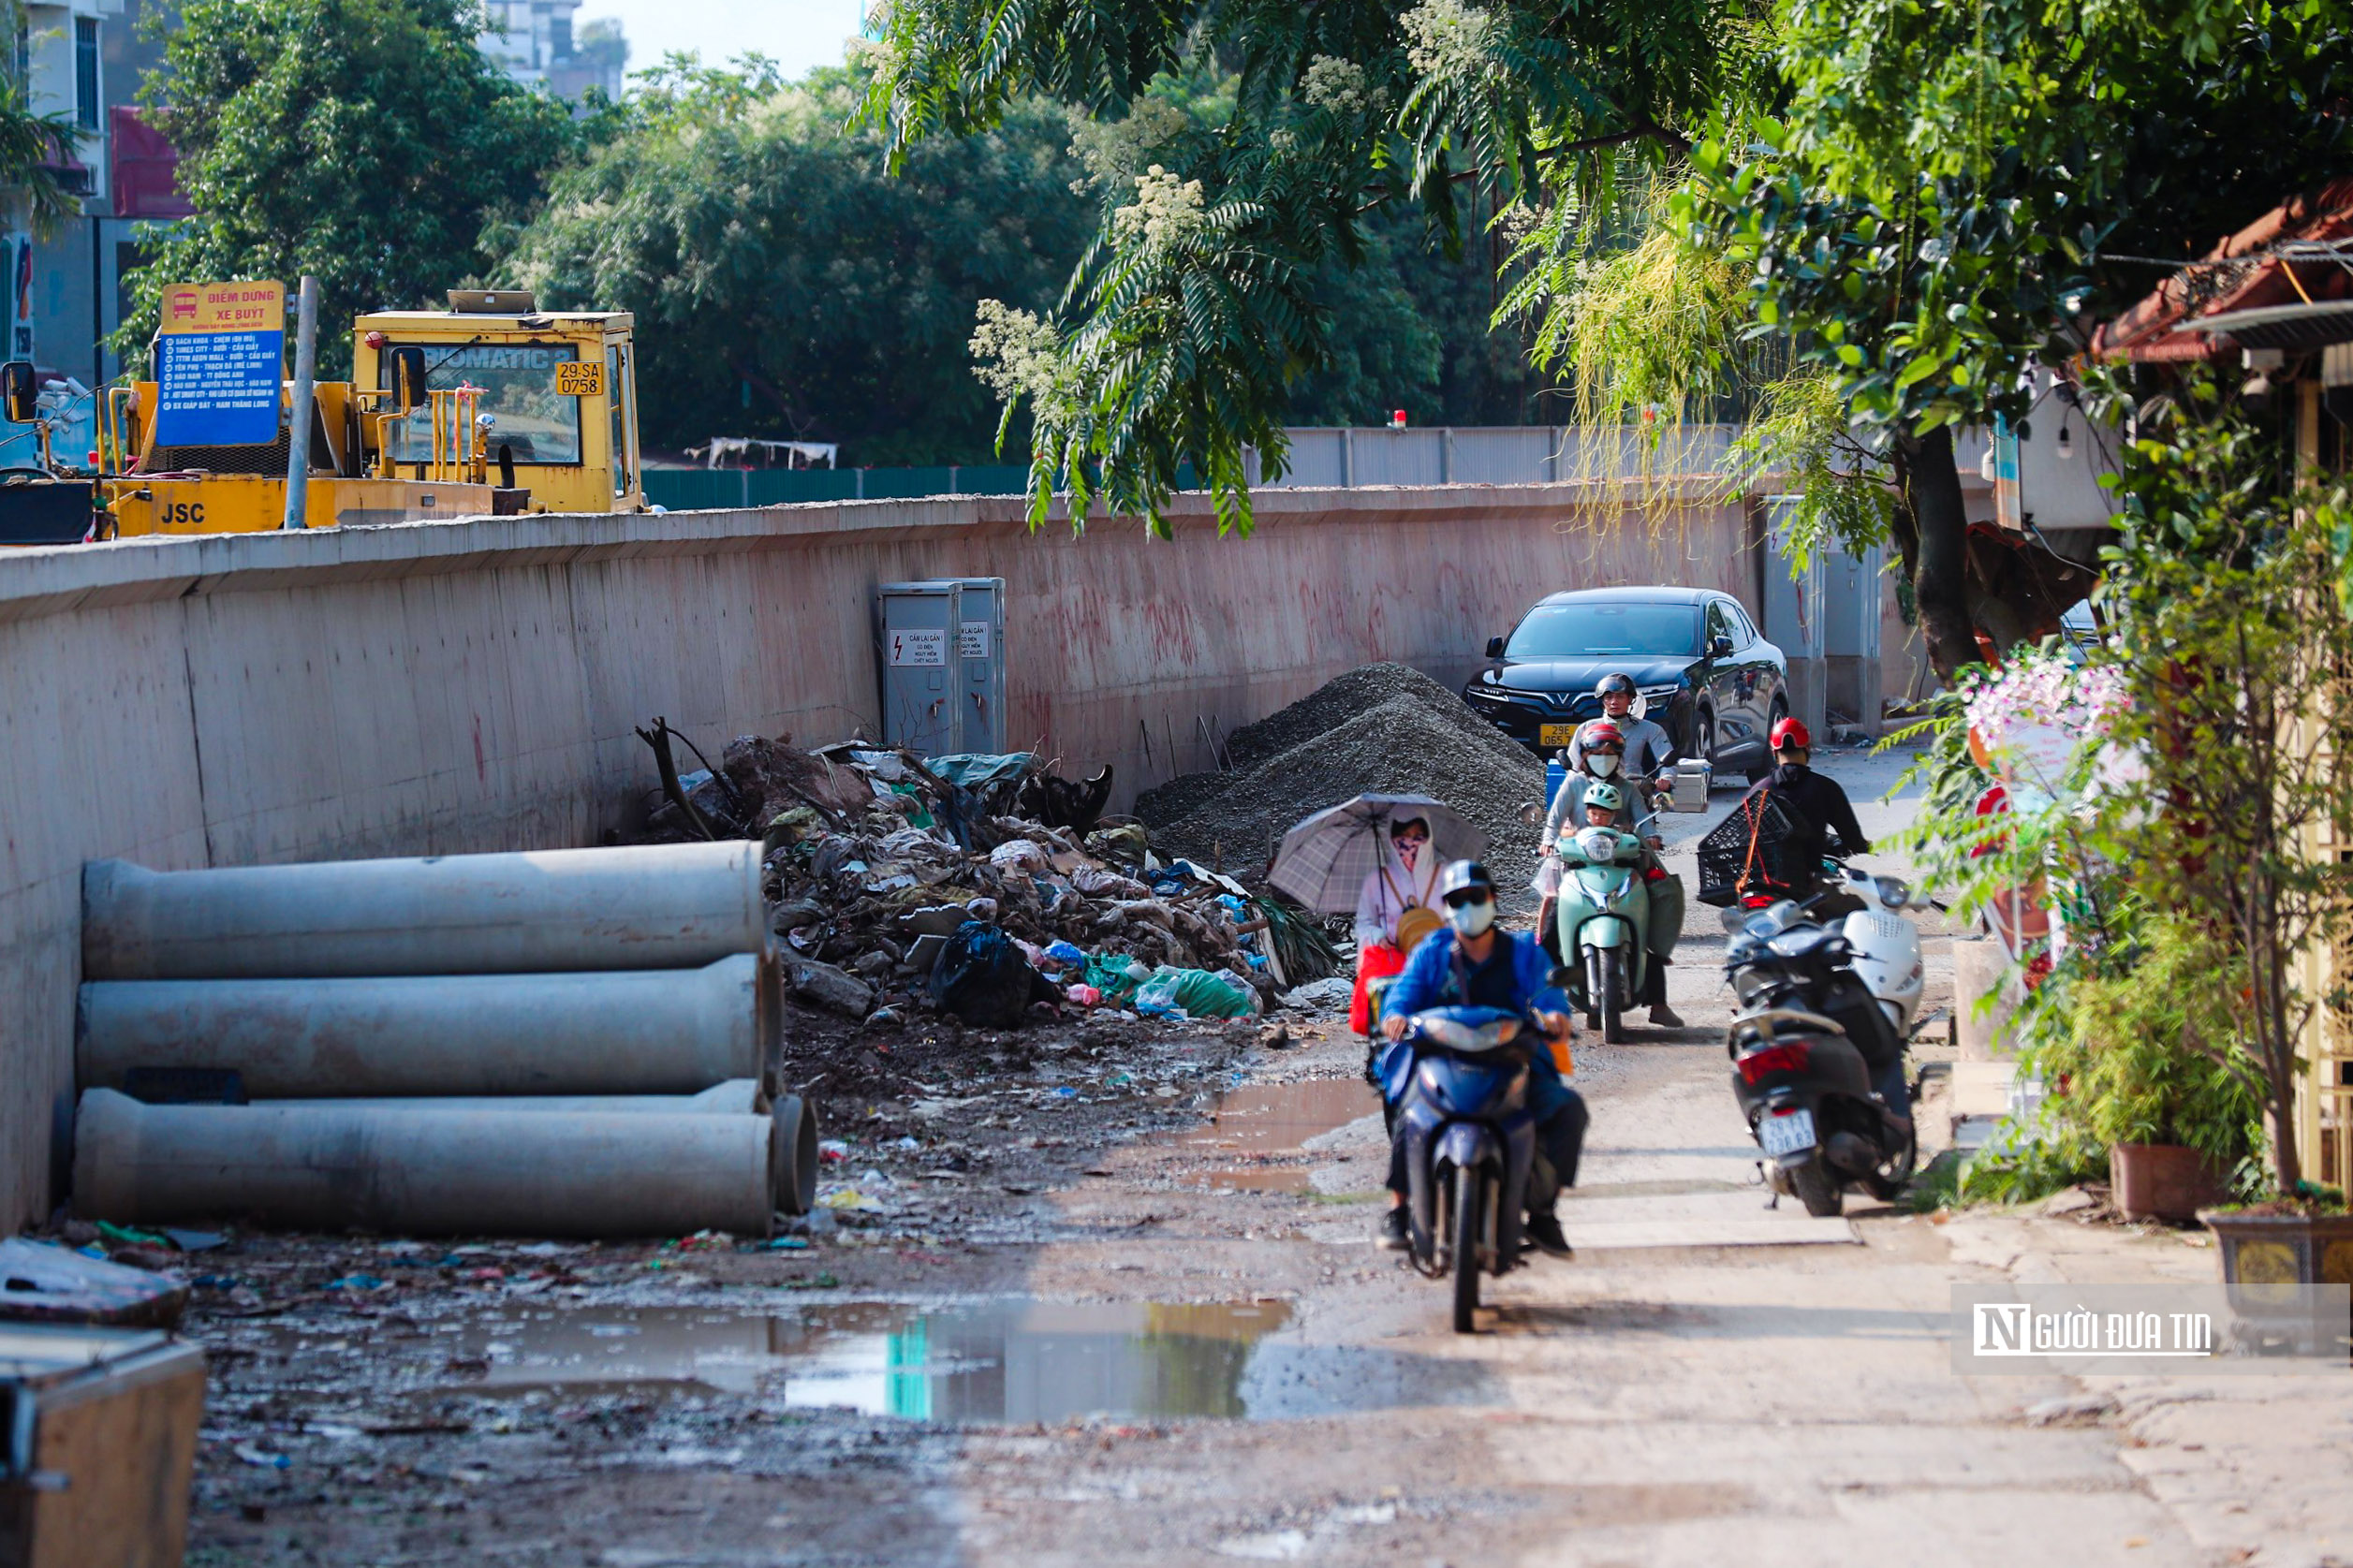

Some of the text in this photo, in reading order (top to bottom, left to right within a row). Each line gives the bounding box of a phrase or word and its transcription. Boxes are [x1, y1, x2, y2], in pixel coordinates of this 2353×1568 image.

[208, 288, 274, 303] ĐIỂM DỪNG
[217, 306, 264, 320] XE BUÝT
[562, 380, 597, 393] 0758
[161, 503, 205, 524] JSC
[1552, 725, 1570, 735] 29E
[1545, 735, 1572, 745] 065.7
